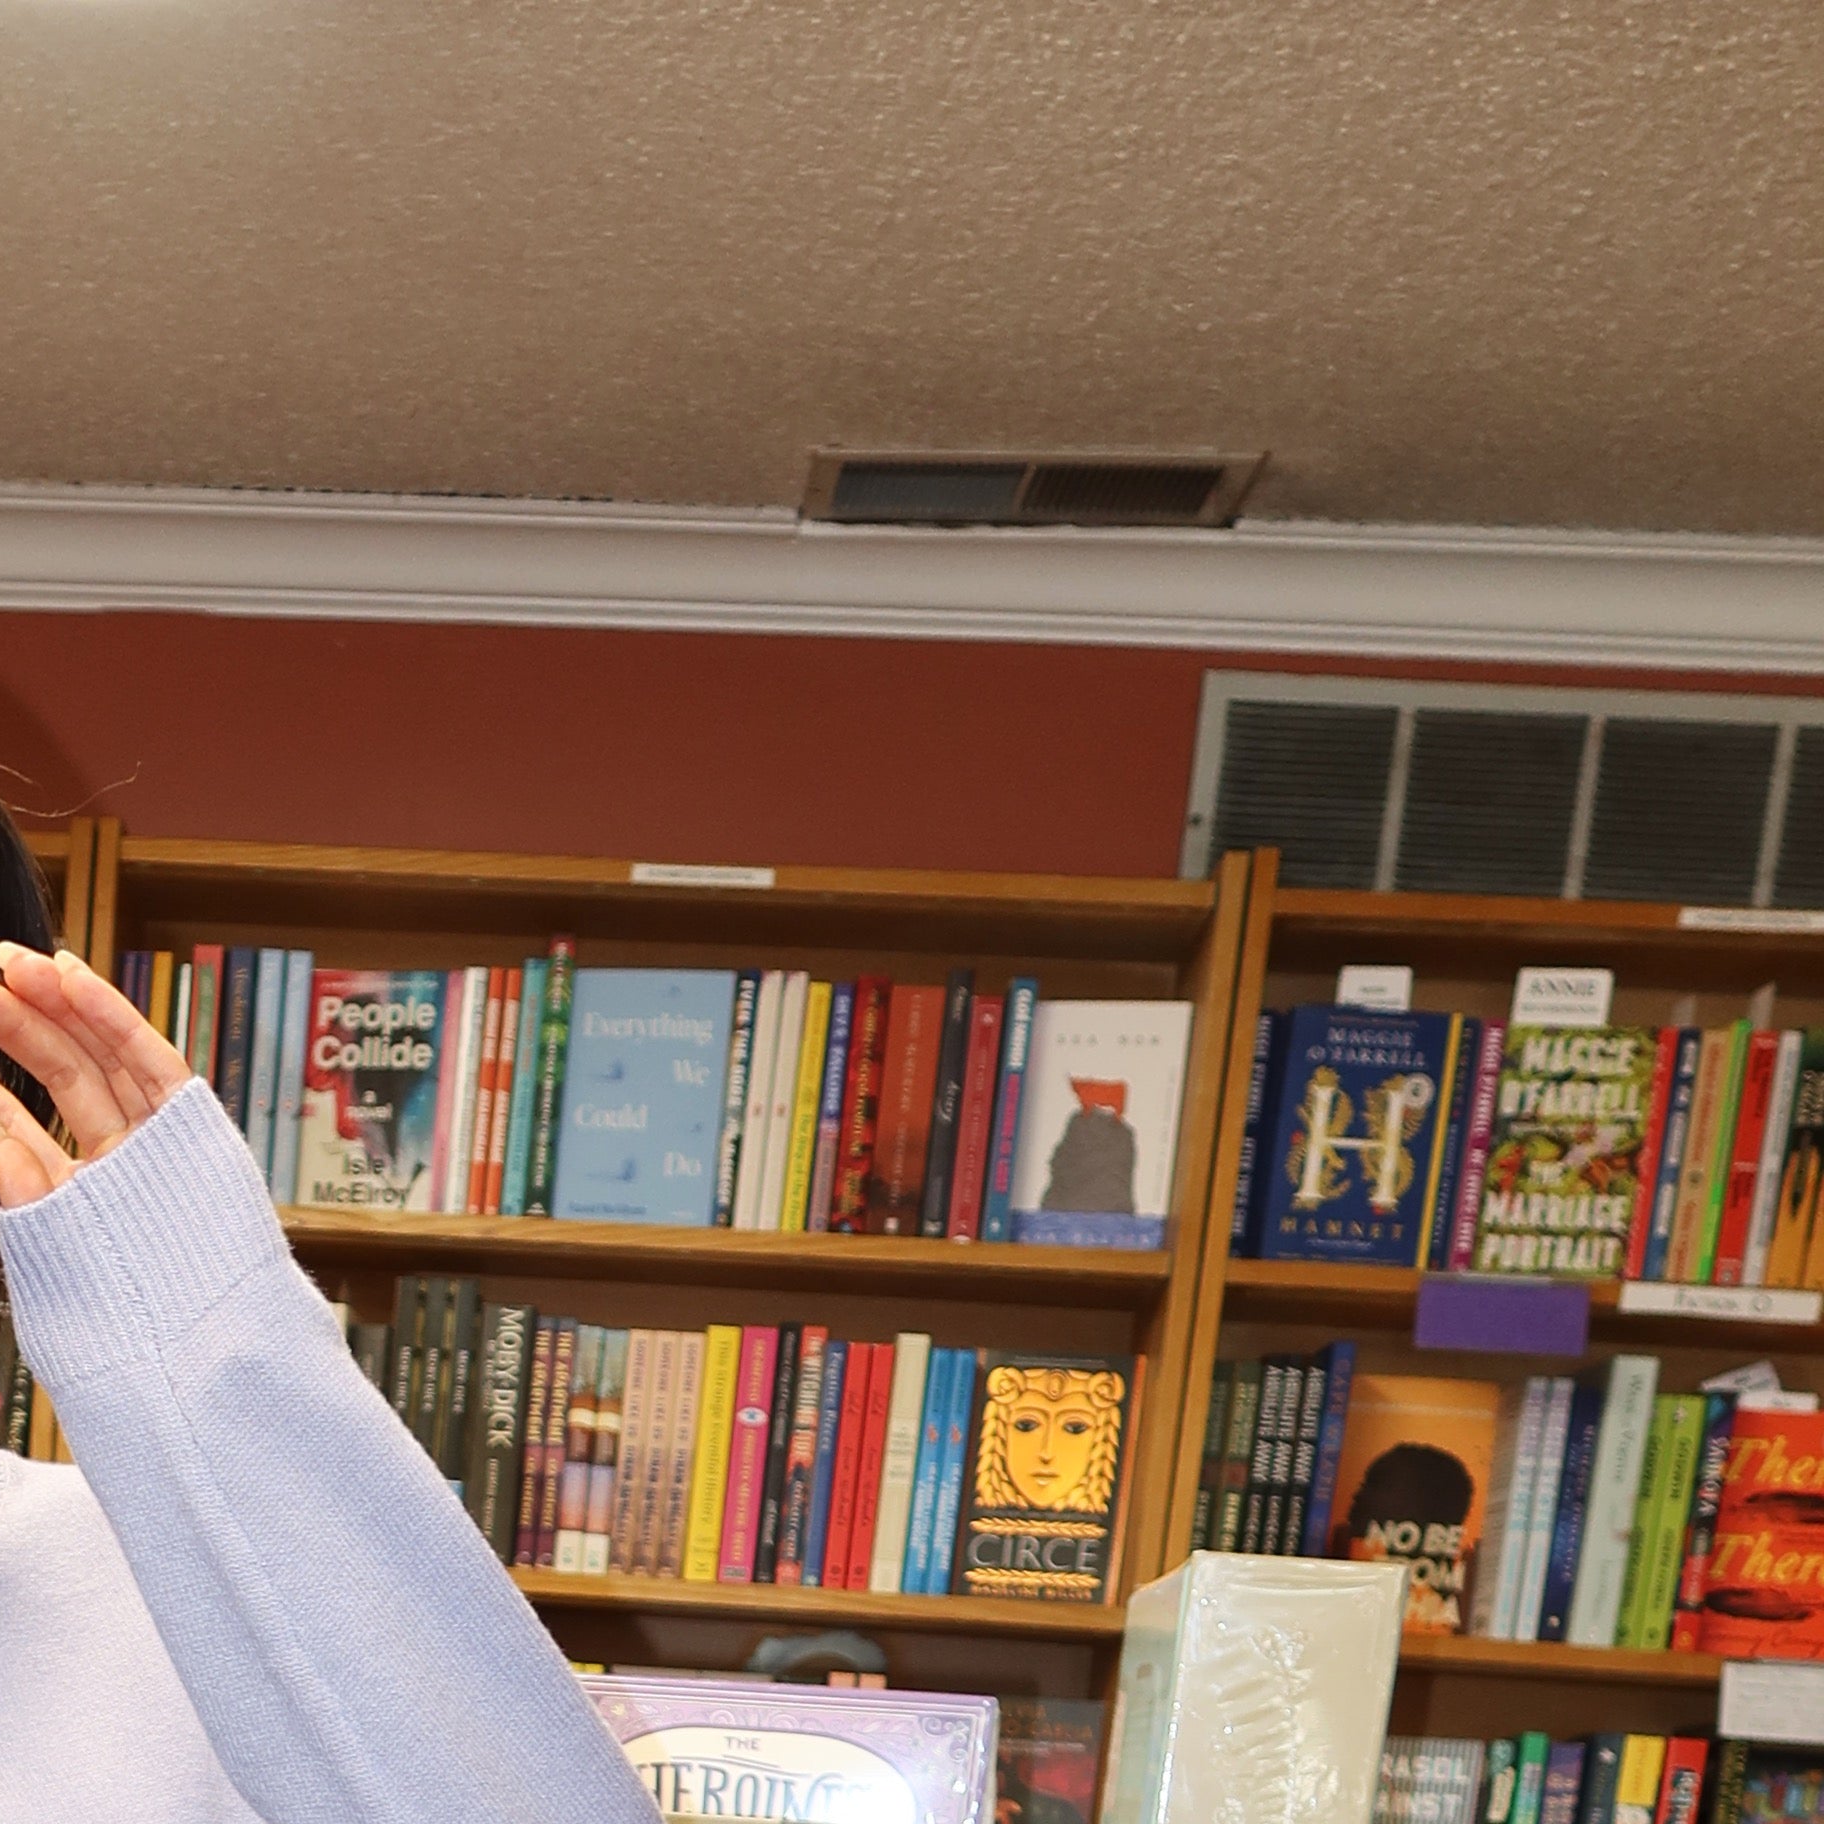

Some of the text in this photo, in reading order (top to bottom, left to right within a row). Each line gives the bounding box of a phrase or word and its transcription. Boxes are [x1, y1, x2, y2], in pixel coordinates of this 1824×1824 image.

[1528, 980, 1596, 997] ANNIE
[319, 995, 436, 1035] People
[581, 1011, 714, 1045] Everything
[313, 1034, 433, 1071] Collide
[673, 1057, 711, 1085] We
[346, 1103, 392, 1120] novel
[576, 1102, 648, 1130] Could
[342, 1153, 385, 1176] Isle
[663, 1151, 703, 1178] Do
[314, 1181, 410, 1208] McElroy
[1482, 1190, 1630, 1233] MARRIAGE
[1478, 1232, 1623, 1270] PORTRAIT
[526, 1360, 550, 1445] APARTMENT
[547, 1360, 571, 1445] APARTMENT
[967, 1533, 1102, 1573] CIRCE
[1366, 1519, 1465, 1554] NO BE
[723, 1736, 761, 1751] THE
